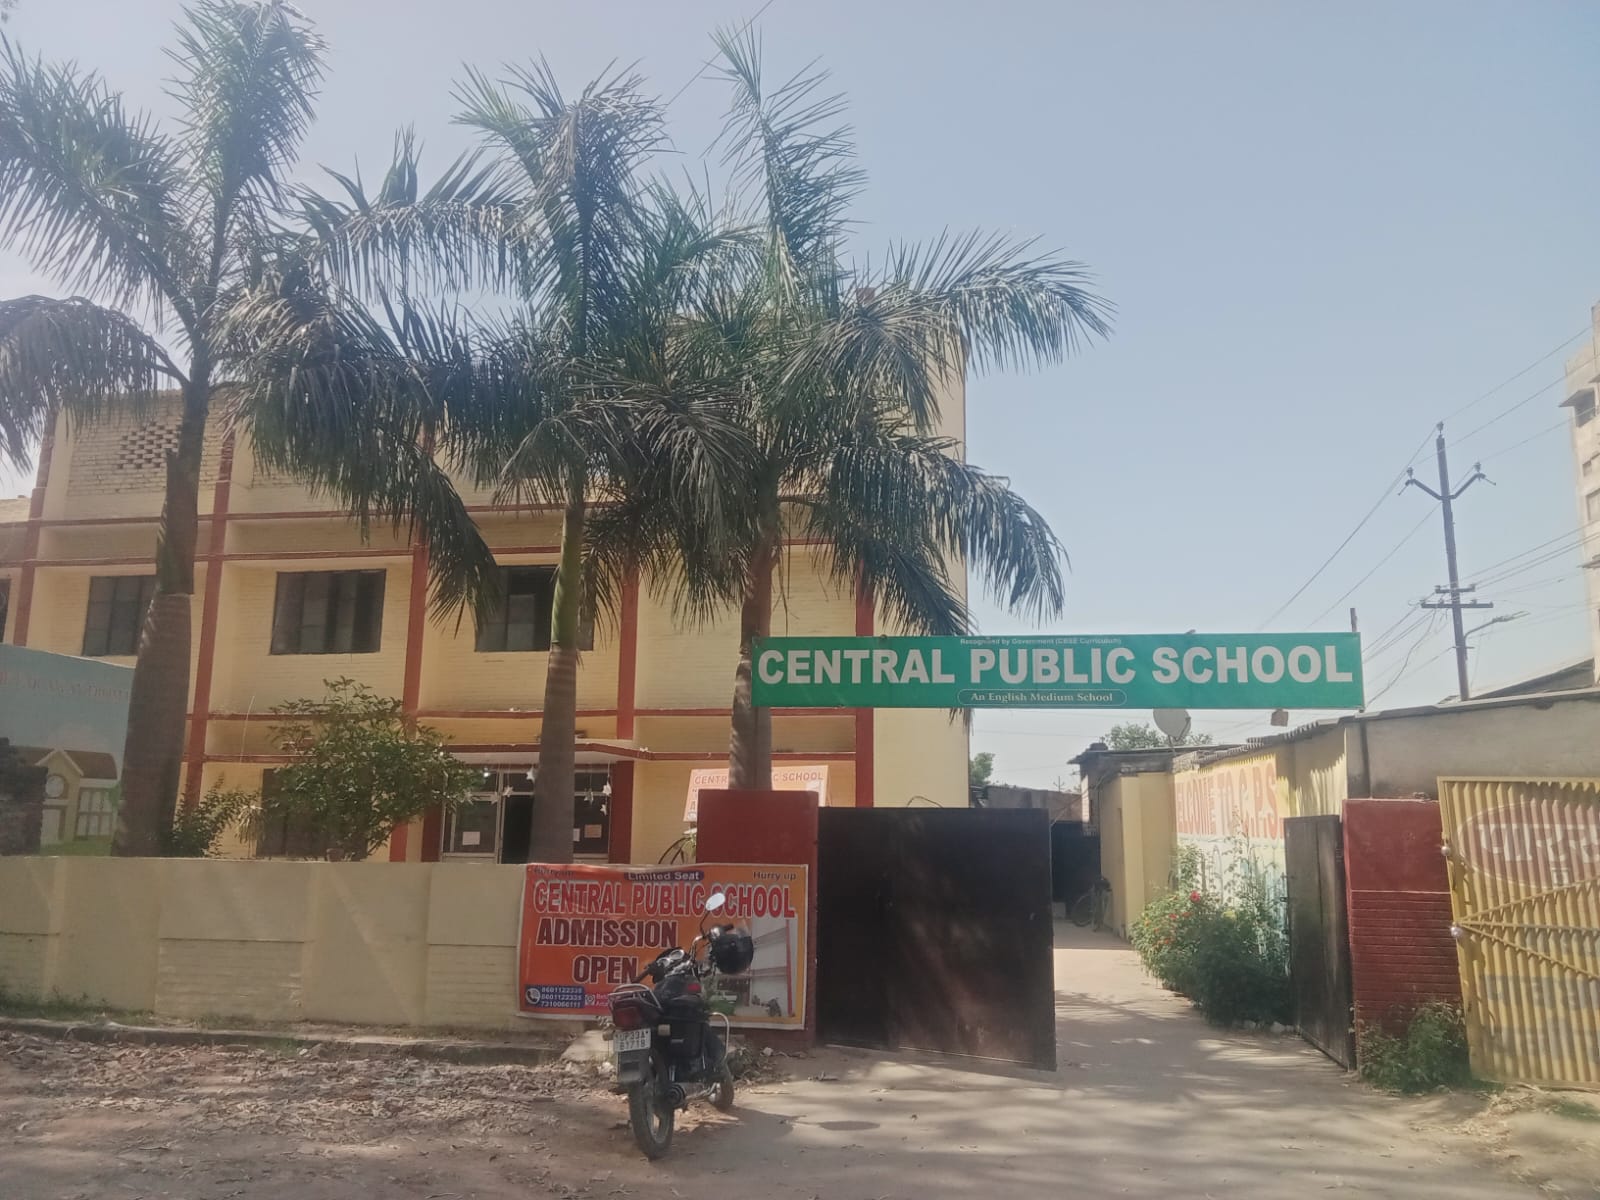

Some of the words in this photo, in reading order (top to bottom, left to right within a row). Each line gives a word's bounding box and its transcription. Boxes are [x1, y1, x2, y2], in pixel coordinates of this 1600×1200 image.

[758, 649, 956, 684] CENTRAL
[970, 648, 1136, 684] PUBLIC
[1152, 645, 1353, 684] SCHOOL
[971, 693, 985, 701] An
[988, 692, 1028, 704] English
[1031, 692, 1074, 702] Medium
[1077, 691, 1114, 702] School
[694, 774, 728, 785] CENTR
[783, 771, 824, 782] SCHOOL
[627, 871, 671, 881] Limited
[674, 871, 700, 881] Seat
[753, 871, 780, 881] Hurry
[783, 872, 797, 881] up
[534, 880, 626, 916] CENTRAL
[631, 883, 706, 918] PUBLIC
[536, 917, 679, 948] ADMISSION
[572, 954, 638, 984] OPEN
